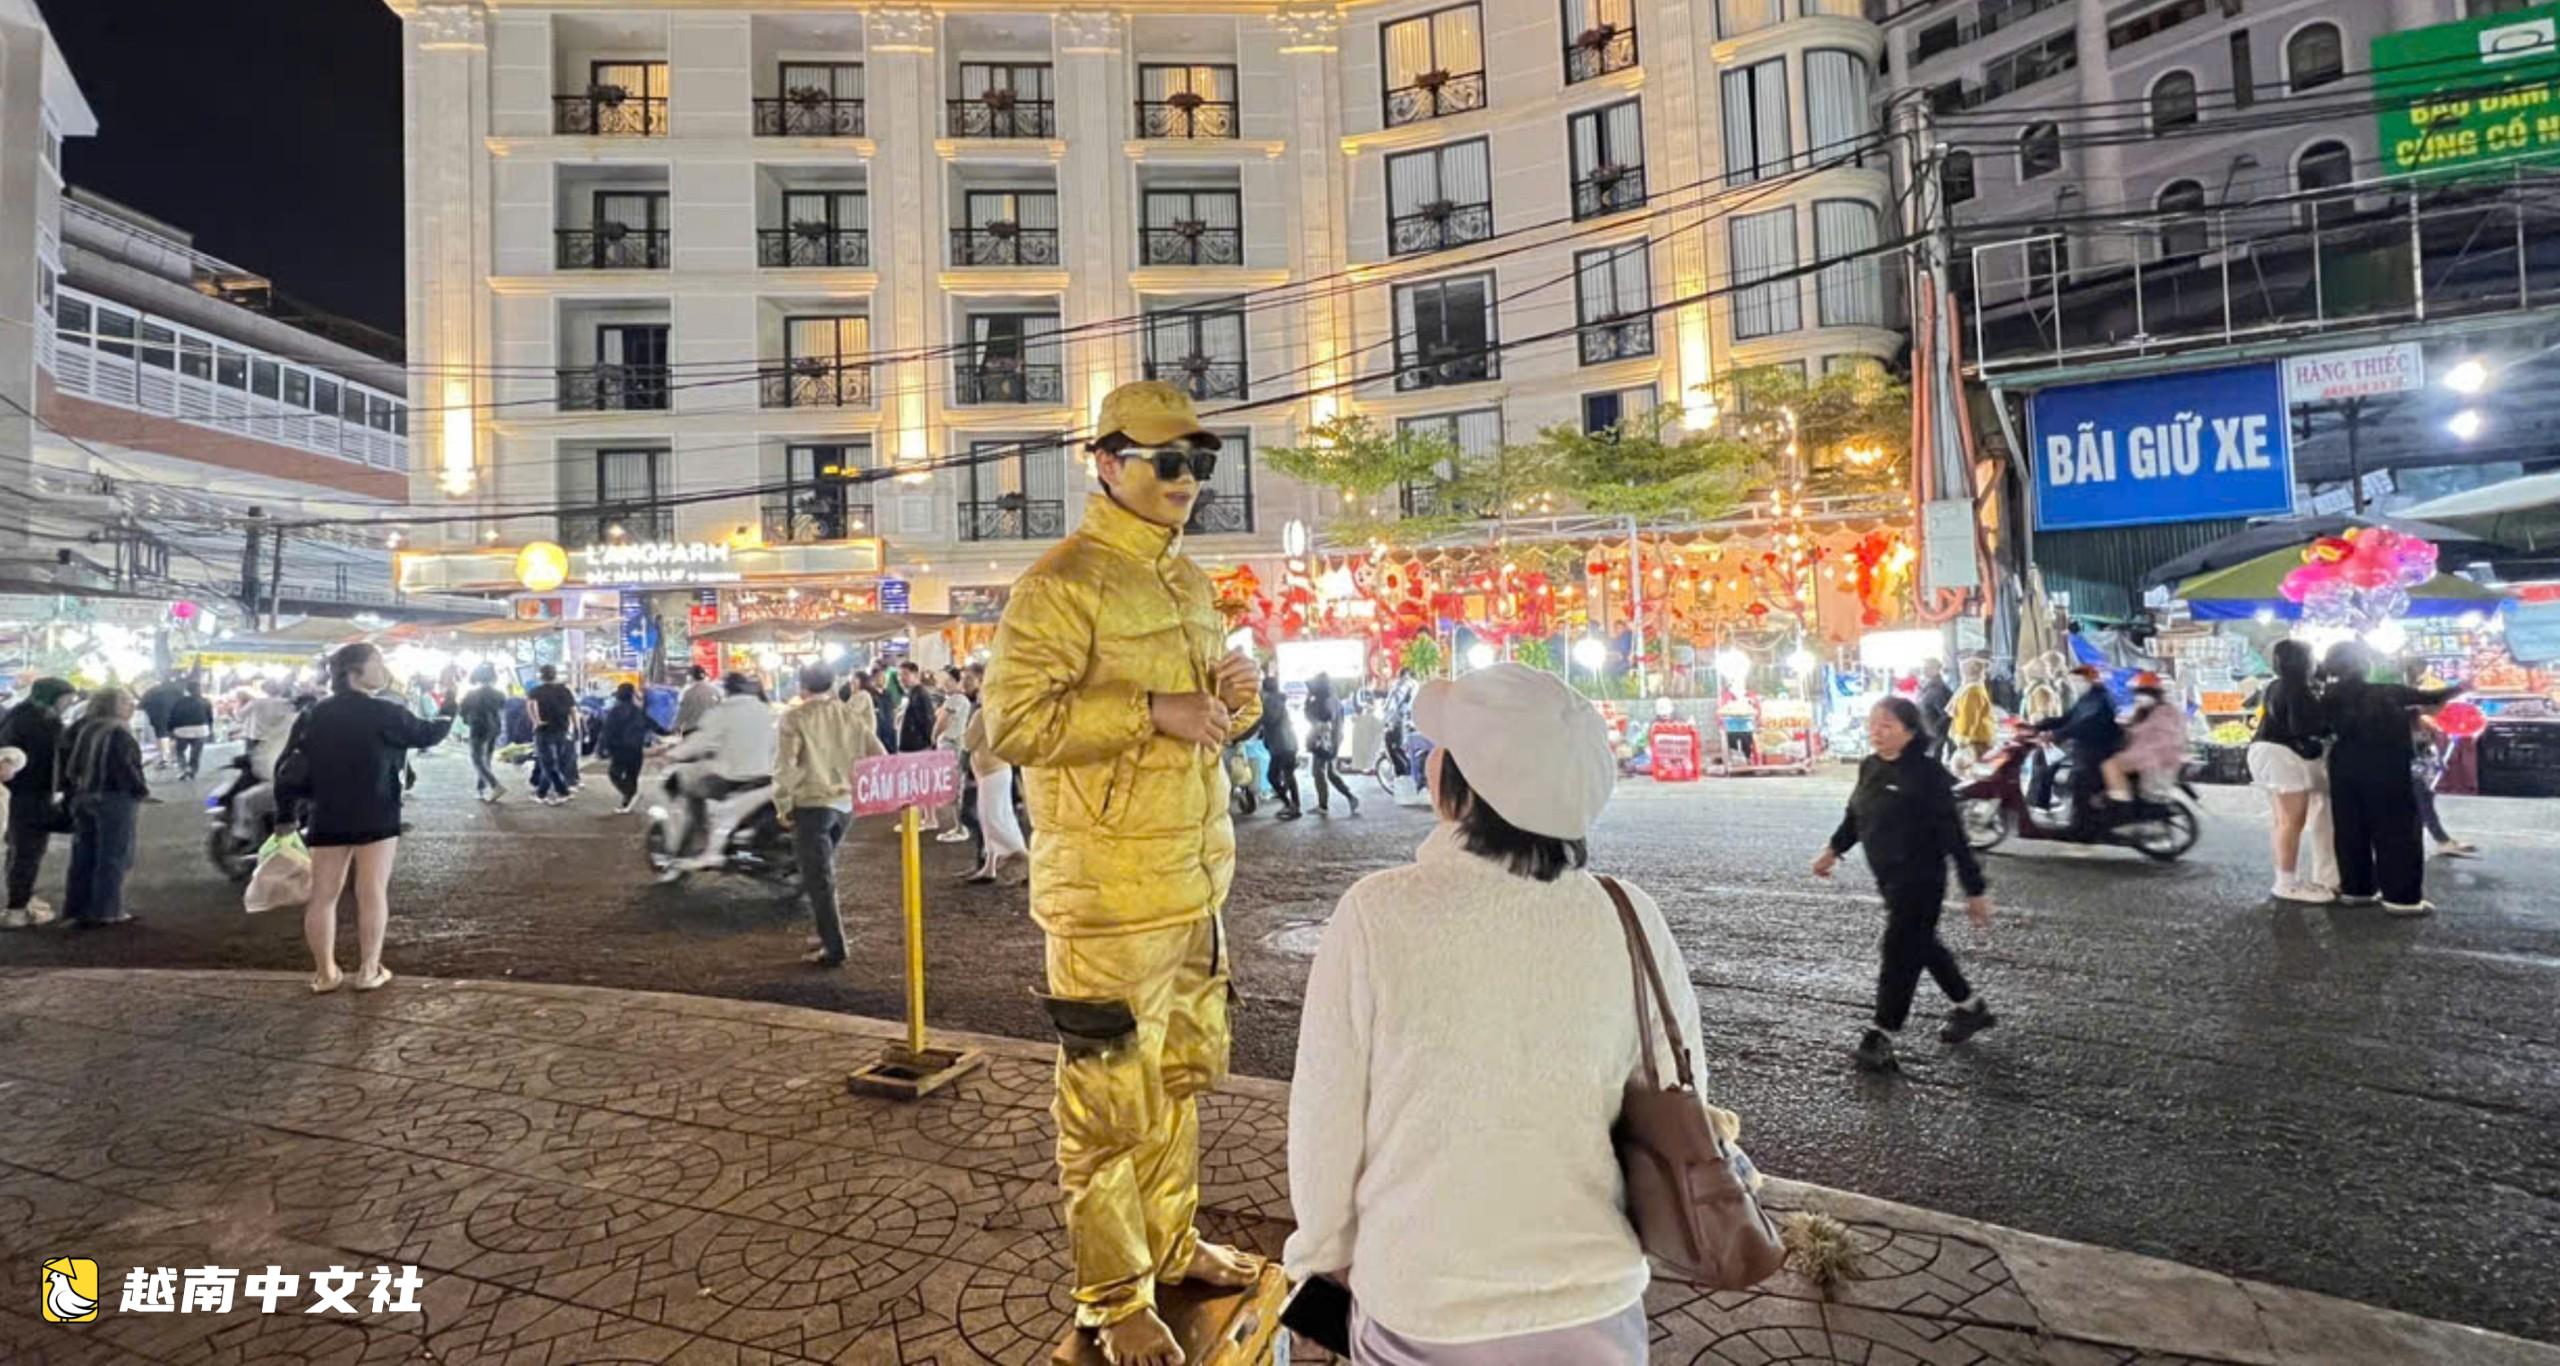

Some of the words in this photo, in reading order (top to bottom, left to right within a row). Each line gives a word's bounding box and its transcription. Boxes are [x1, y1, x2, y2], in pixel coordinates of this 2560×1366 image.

[2296, 359, 2347, 386] HÀNG
[2351, 347, 2410, 379] THIẾC
[2047, 420, 2117, 487] BÃI
[2127, 411, 2203, 480] GIỮ
[2211, 414, 2271, 472] XE
[857, 764, 894, 804] CẤM
[933, 766, 953, 794] XE
